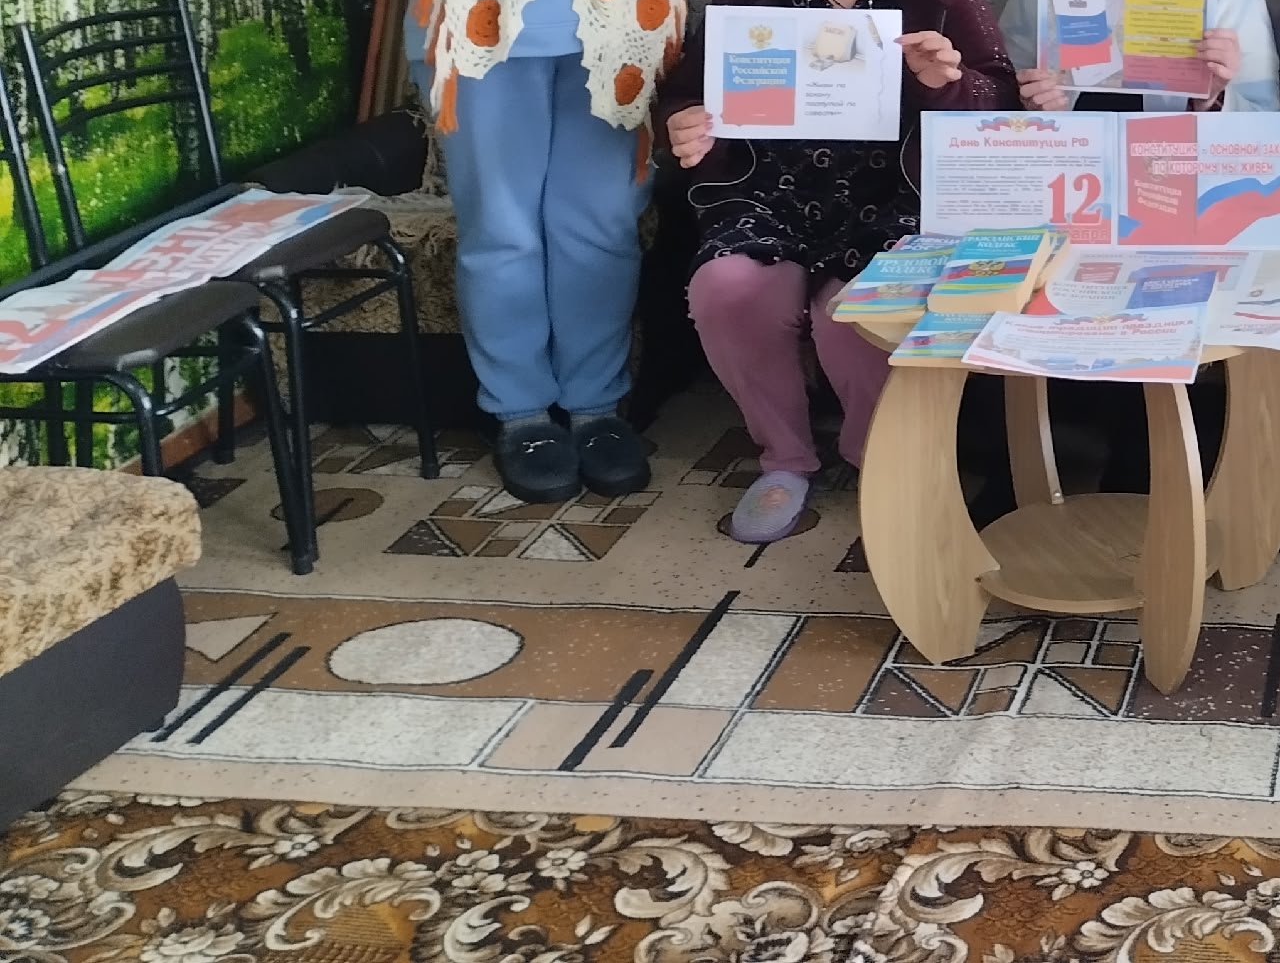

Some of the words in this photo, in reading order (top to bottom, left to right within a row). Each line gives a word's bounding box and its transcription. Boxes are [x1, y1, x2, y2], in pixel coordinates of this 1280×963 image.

[949, 137, 980, 148] День
[984, 137, 1067, 149] Конституции
[1071, 137, 1089, 147] РФ
[1131, 142, 1198, 156] КОНСТИТУЦИЯ
[1210, 142, 1258, 155] ОСНОВНОЙ
[1152, 161, 1167, 175] ПО
[1168, 161, 1218, 175] КОТОРОМУ
[1222, 162, 1236, 174] МЫ
[1047, 172, 1102, 224] 12
